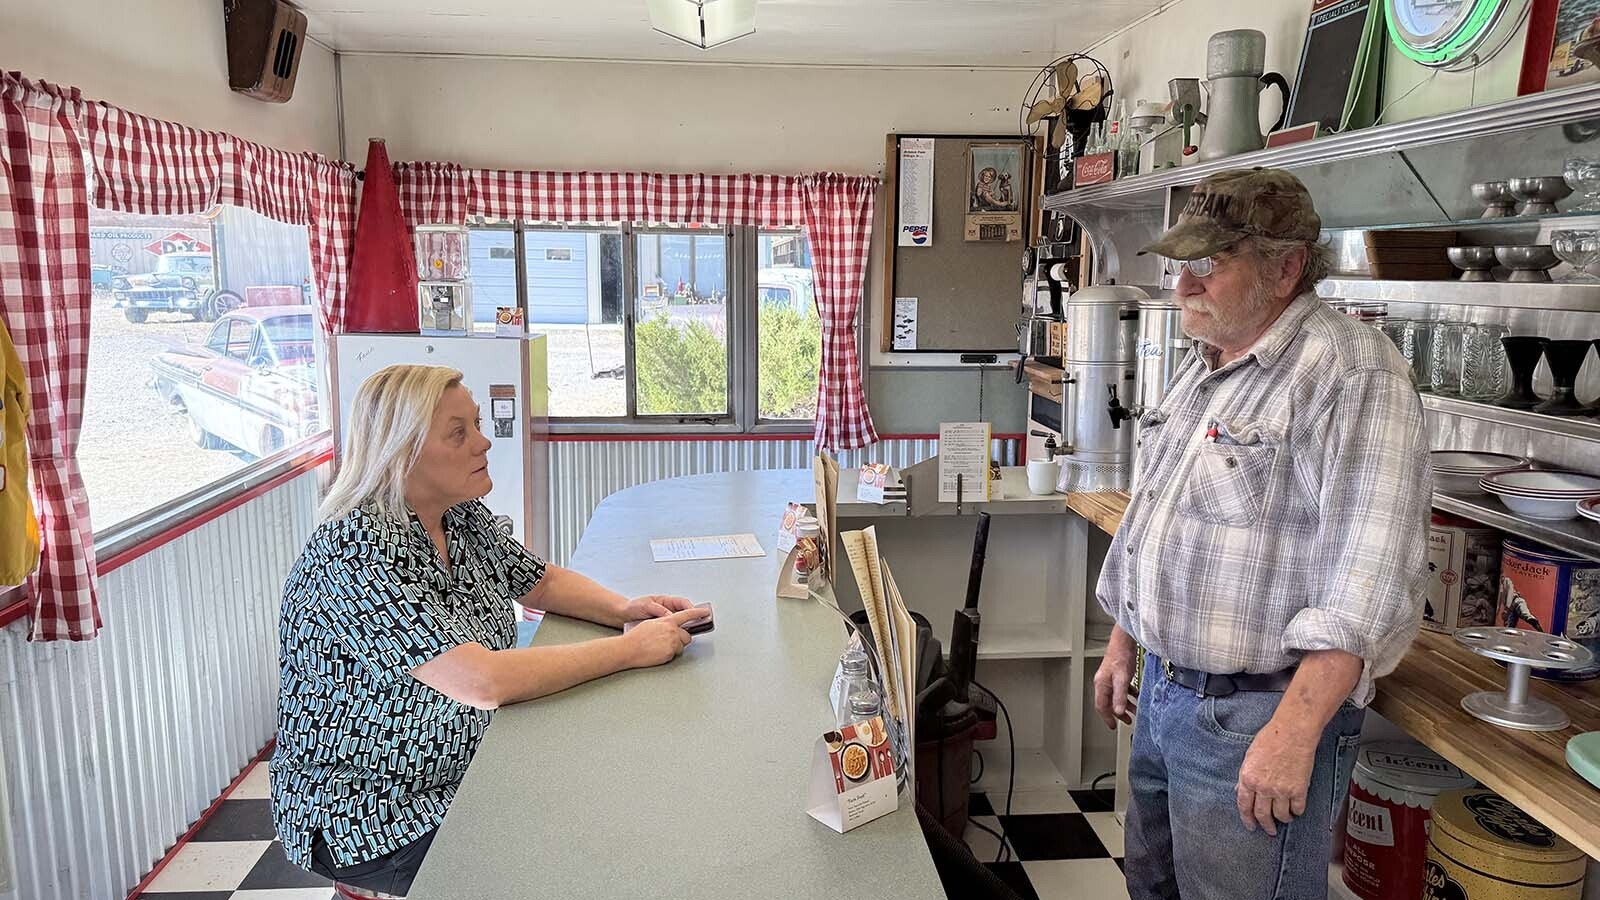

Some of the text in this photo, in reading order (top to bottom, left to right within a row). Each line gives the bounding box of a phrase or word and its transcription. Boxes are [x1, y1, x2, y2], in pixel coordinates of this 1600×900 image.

[1316, 7, 1340, 23] SPECIALS
[903, 225, 928, 233] PEPSI
[1139, 341, 1164, 357] Tea
